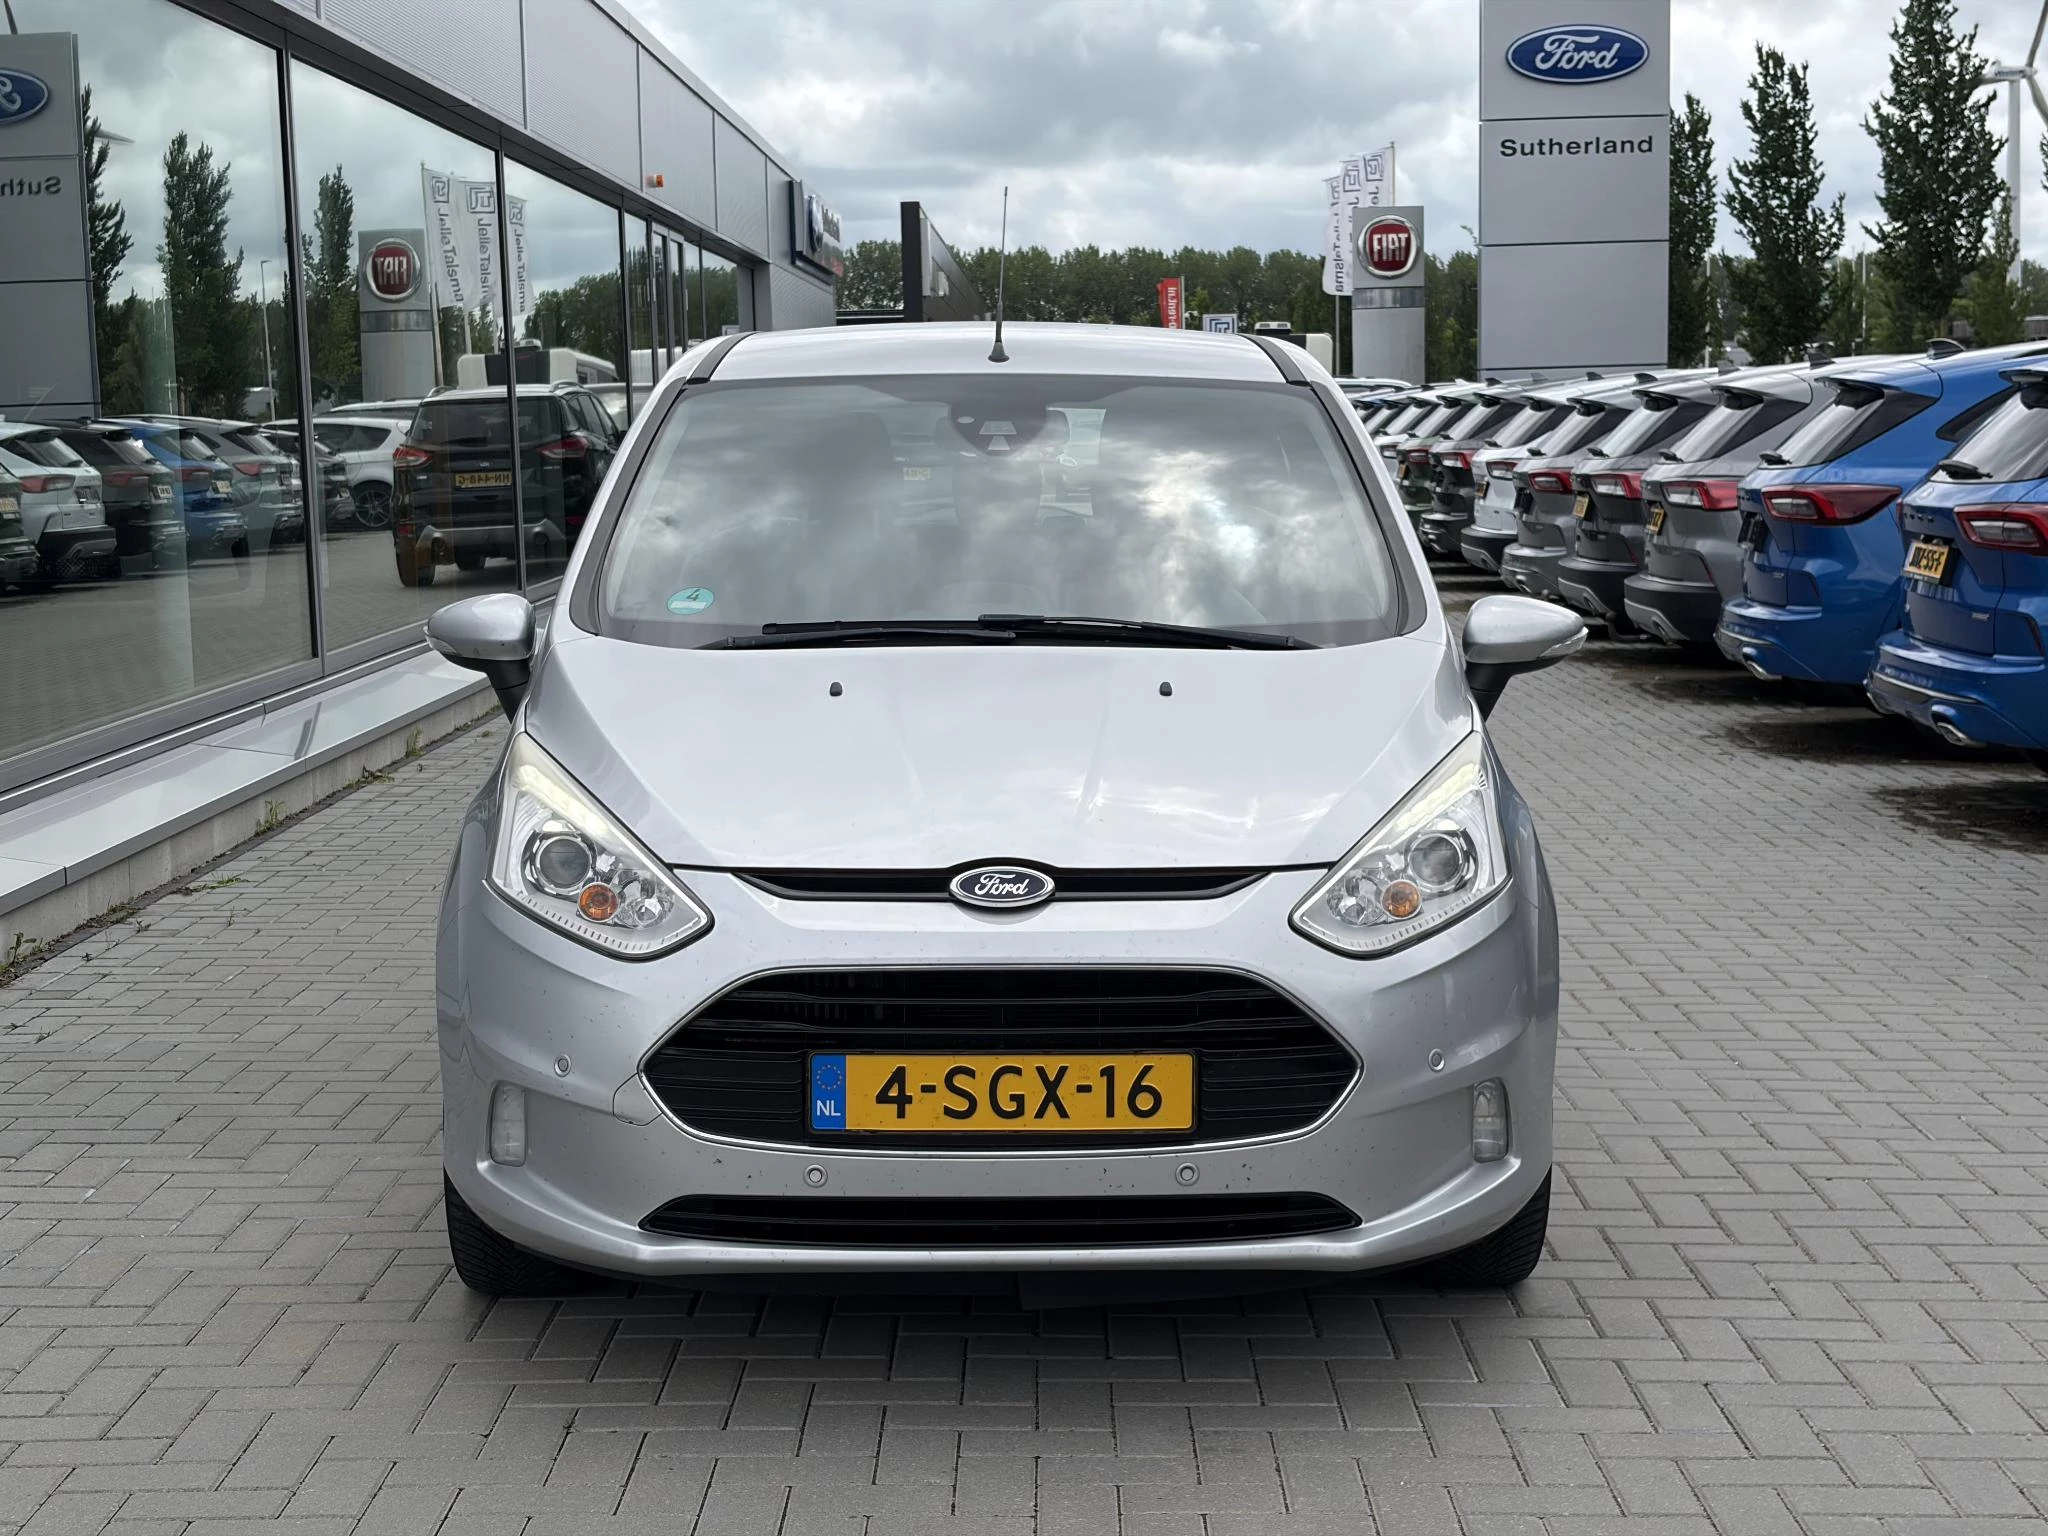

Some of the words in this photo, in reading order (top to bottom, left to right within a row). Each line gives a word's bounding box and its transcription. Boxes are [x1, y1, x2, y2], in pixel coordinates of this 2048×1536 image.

[1535, 34, 1620, 70] Ford
[1500, 135, 1653, 157] Sutherland
[1372, 233, 1408, 262] FIAT
[442, 245, 465, 302] Talsma
[686, 589, 701, 601] 4
[974, 873, 1029, 895] Ford
[816, 1099, 841, 1116] NL
[875, 1063, 1163, 1120] 4-SGX-16
